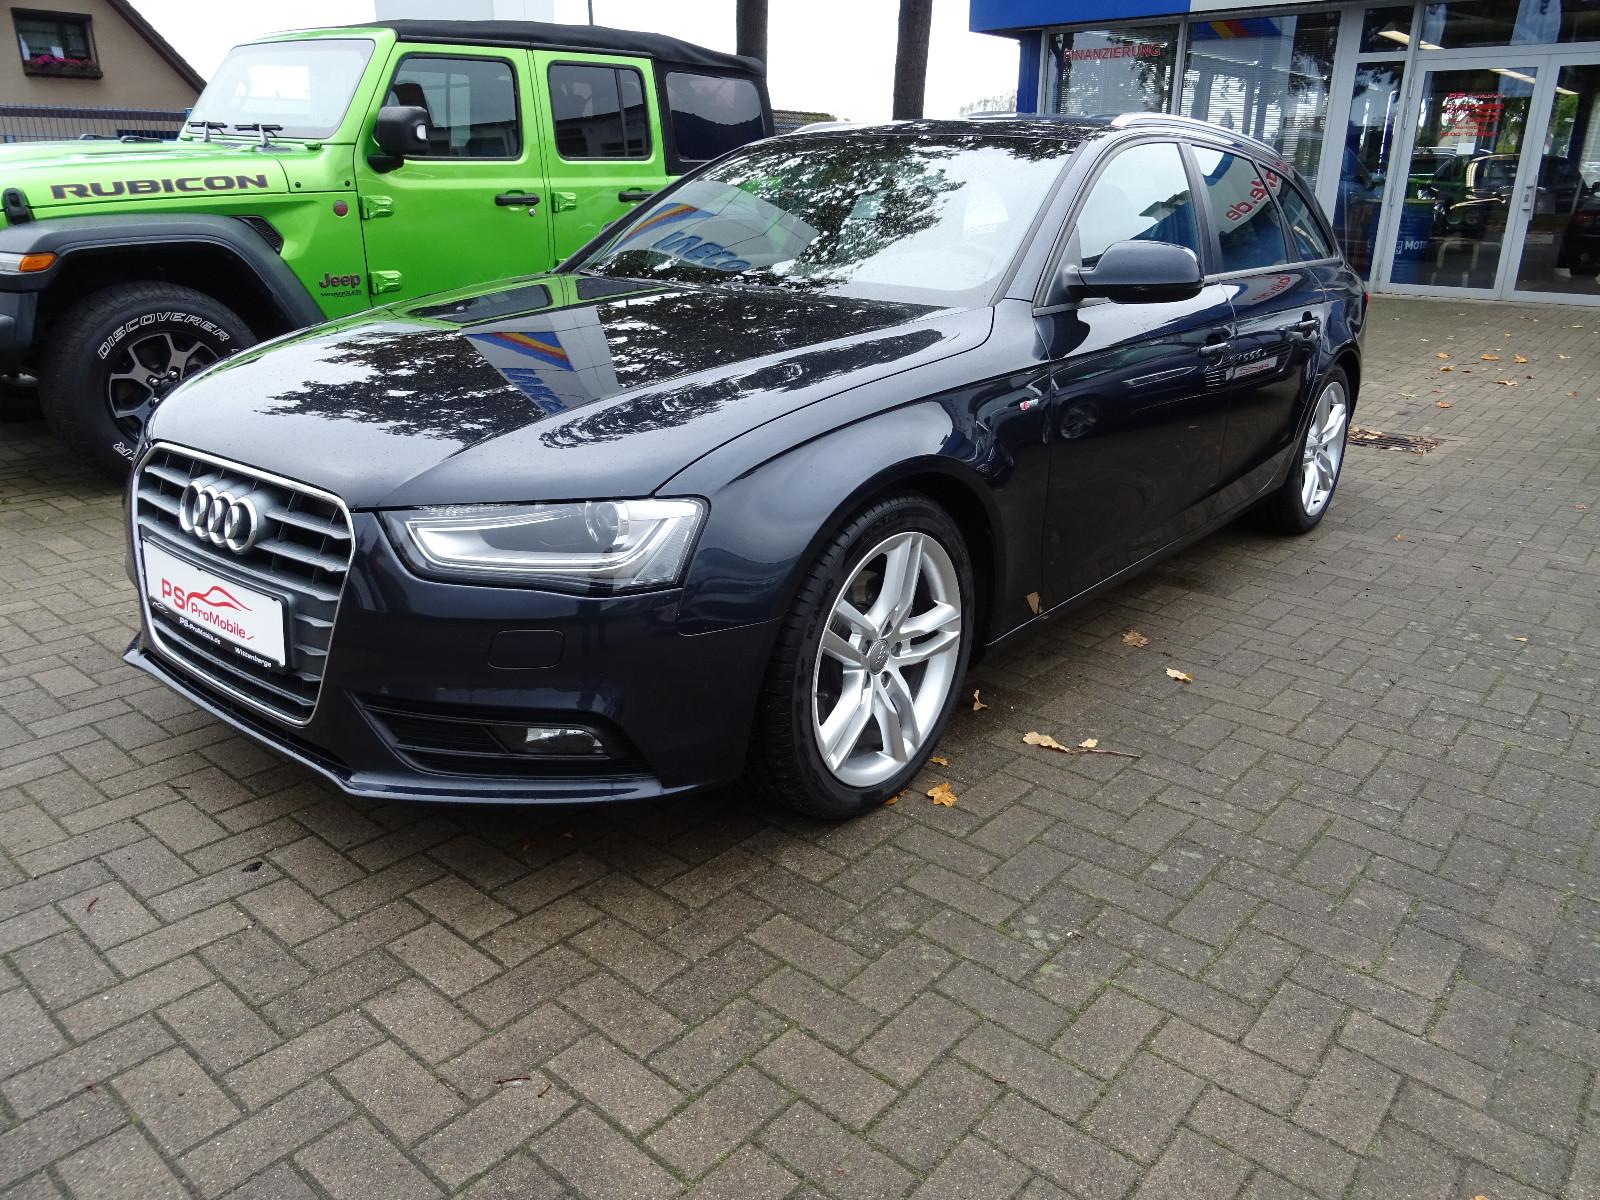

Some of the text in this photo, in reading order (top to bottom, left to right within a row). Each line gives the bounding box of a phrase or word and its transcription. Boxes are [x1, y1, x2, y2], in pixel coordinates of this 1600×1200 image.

[1063, 43, 1160, 61] FINANZIERUNG
[50, 174, 269, 200] RUBICON
[319, 272, 361, 288] Jeep
[97, 311, 230, 359] DISCOVERER
[161, 577, 246, 639] PS ProMobile
[234, 646, 272, 668] Wittenberge
